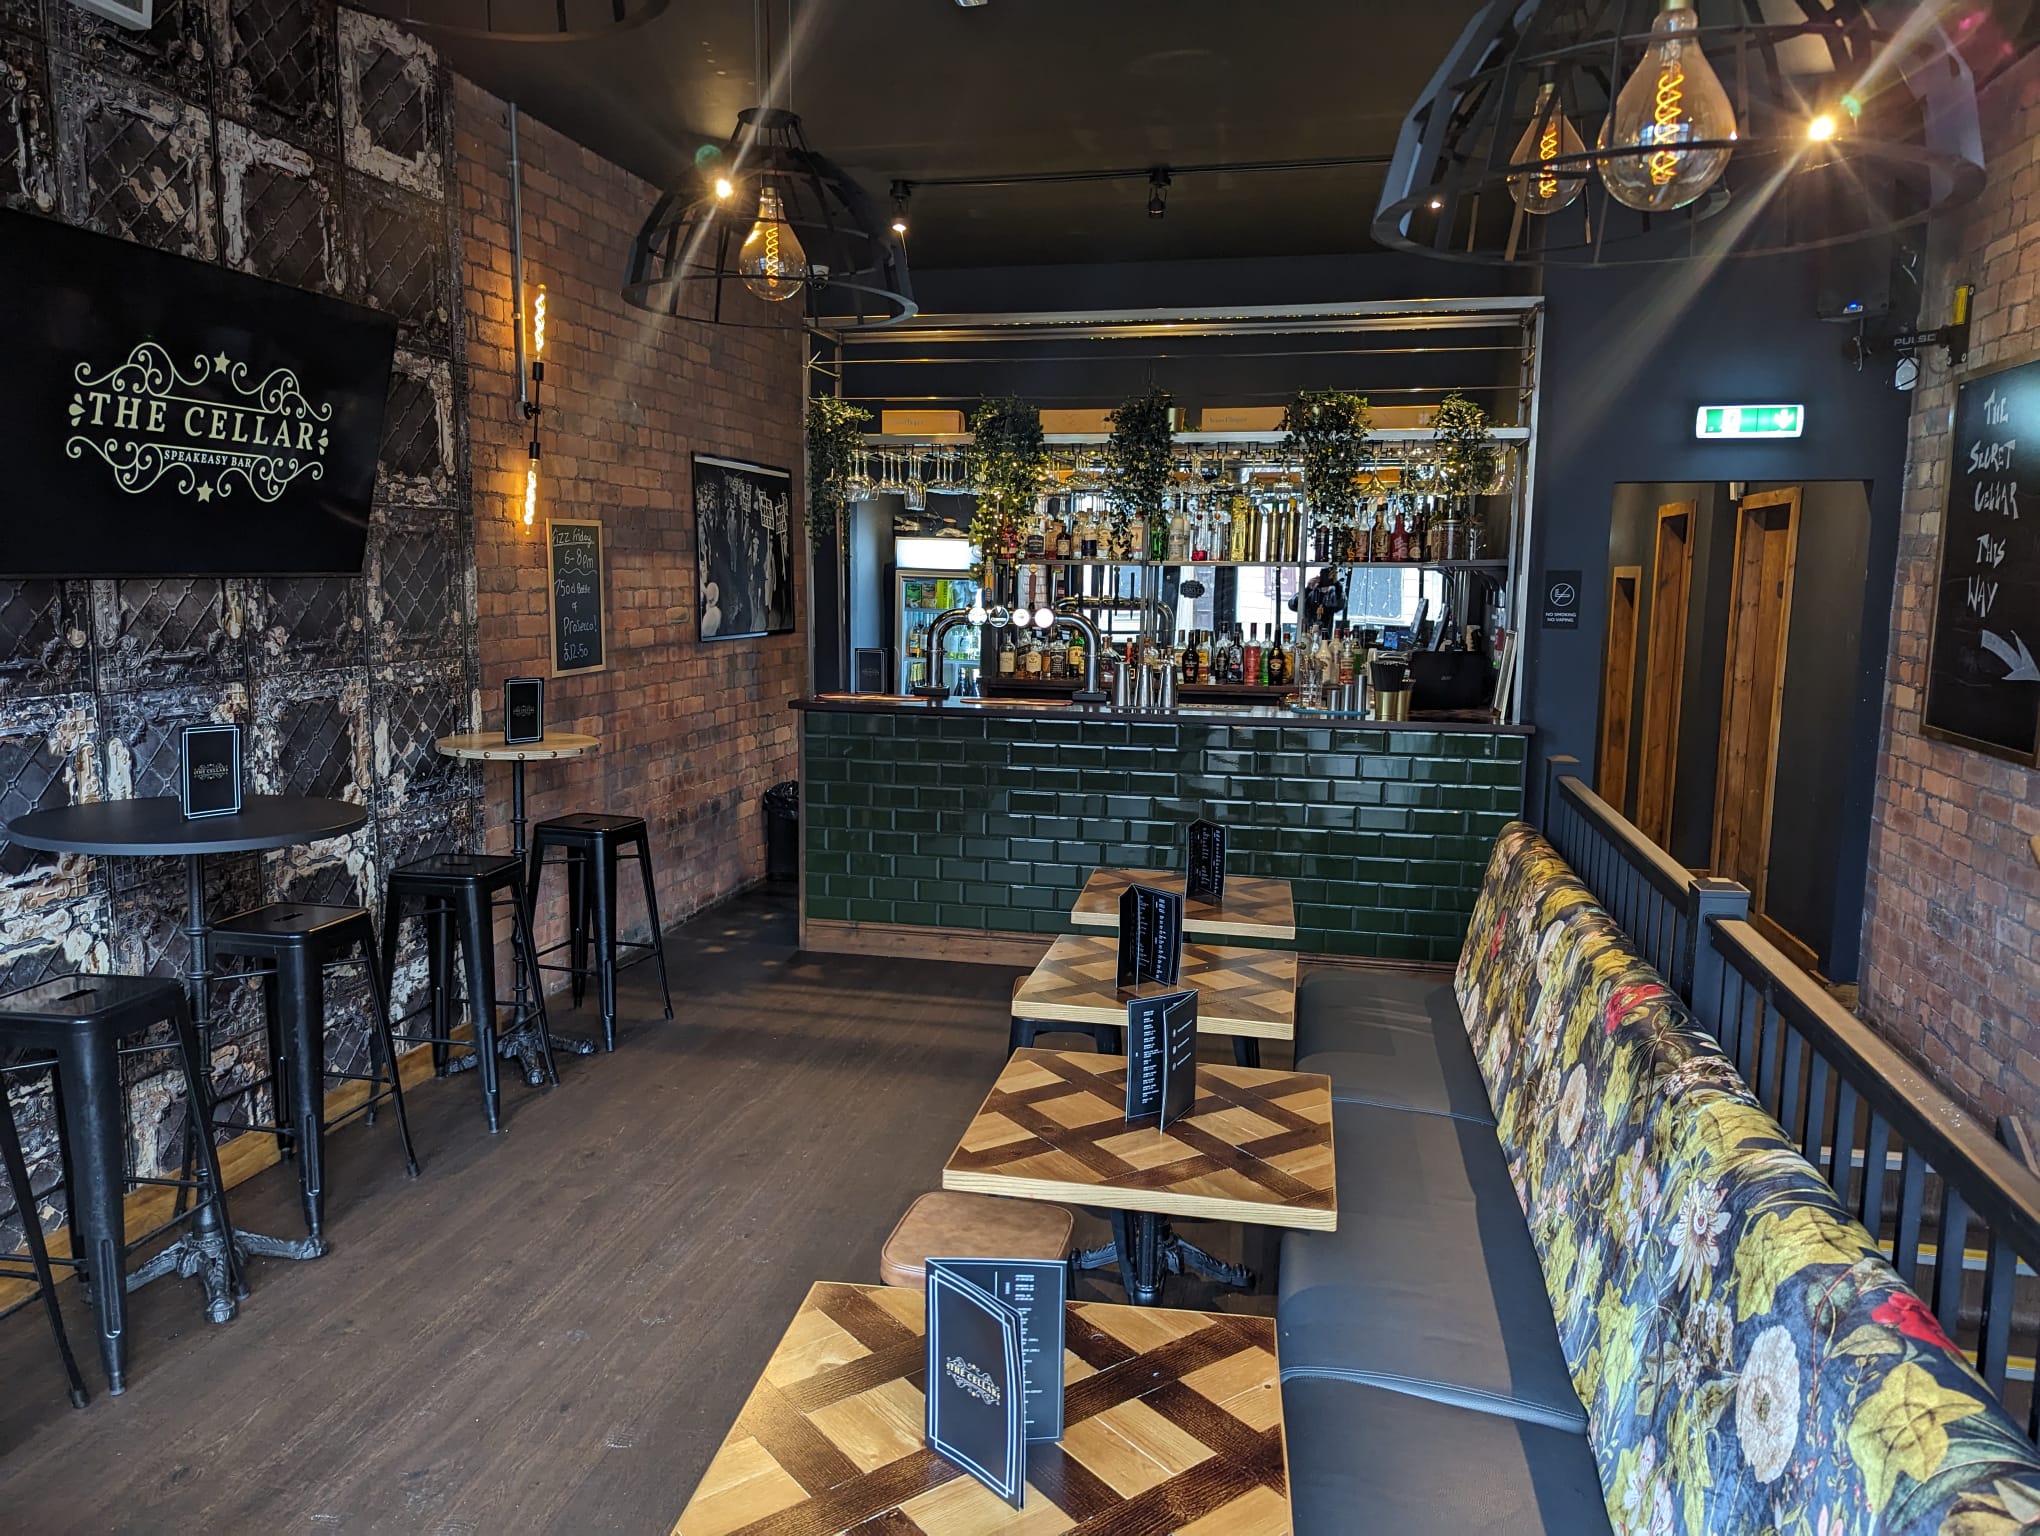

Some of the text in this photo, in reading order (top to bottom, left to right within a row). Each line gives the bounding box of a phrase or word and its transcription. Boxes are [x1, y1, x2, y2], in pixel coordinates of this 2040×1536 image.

[88, 391, 314, 451] THE CELLAR
[1983, 387, 2009, 425] THE
[164, 449, 252, 469] SPEAKEASY BAR
[1967, 439, 2017, 474] SECRET
[1976, 533, 2007, 569] THIS
[1967, 574, 1999, 618] WAY
[950, 1362, 966, 1377] THE
[966, 1373, 998, 1398] CELLAR
